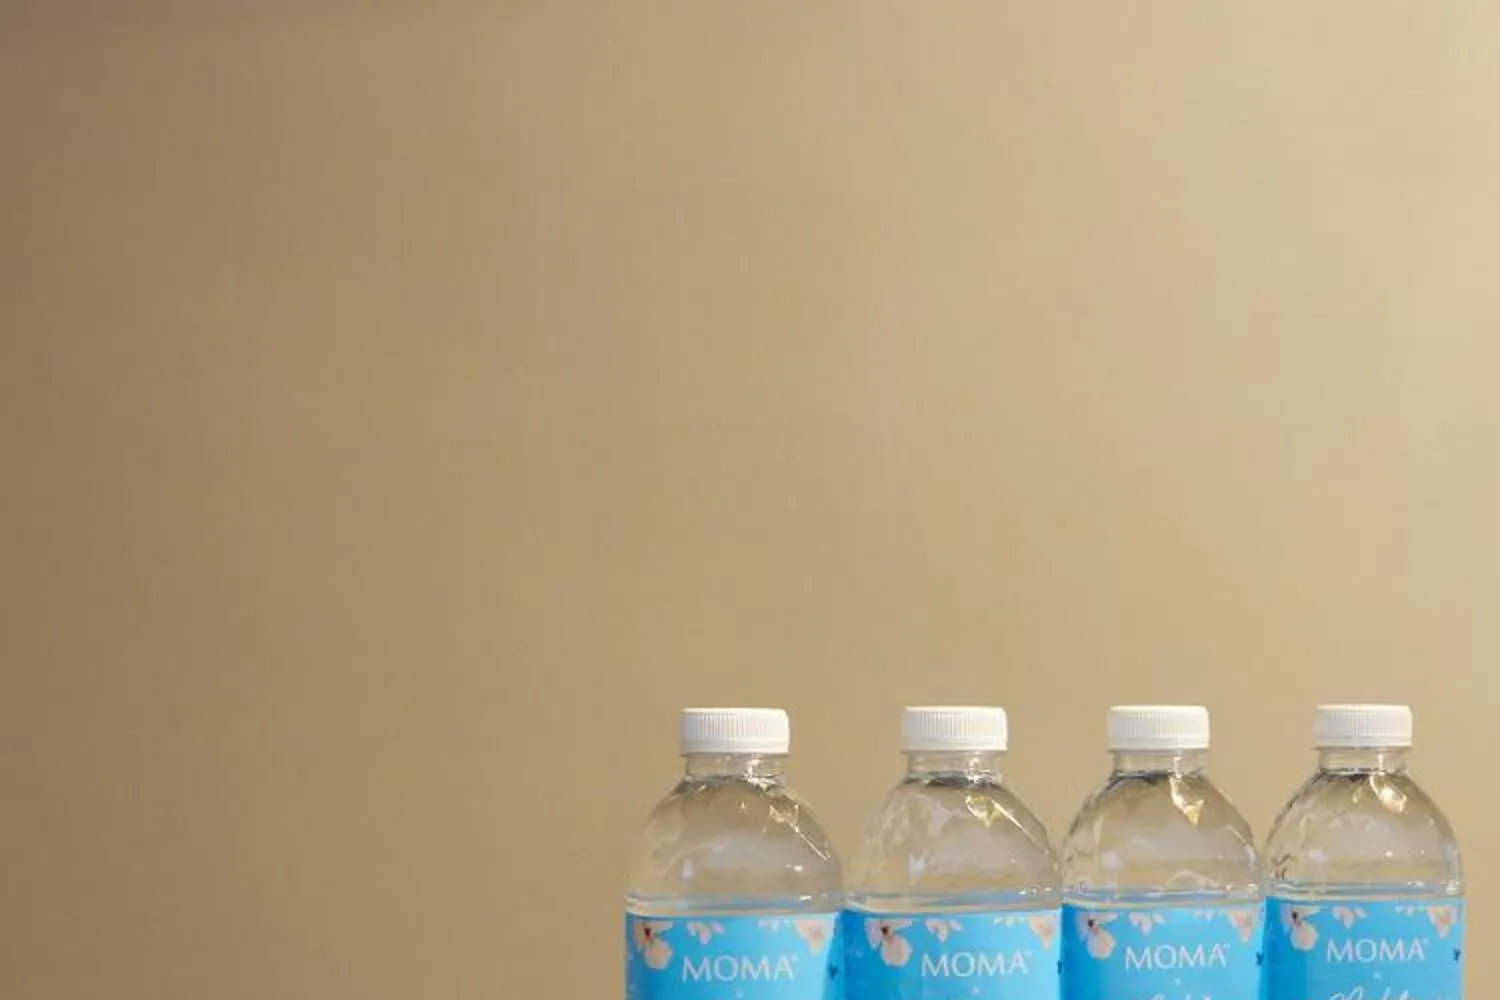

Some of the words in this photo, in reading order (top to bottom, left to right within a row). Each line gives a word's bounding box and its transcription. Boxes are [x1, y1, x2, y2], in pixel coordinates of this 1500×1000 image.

[921, 950, 1029, 978] MOMA
[1124, 942, 1227, 970] MOMA
[1326, 937, 1426, 963] MOMA
[681, 954, 796, 983] MOMA
